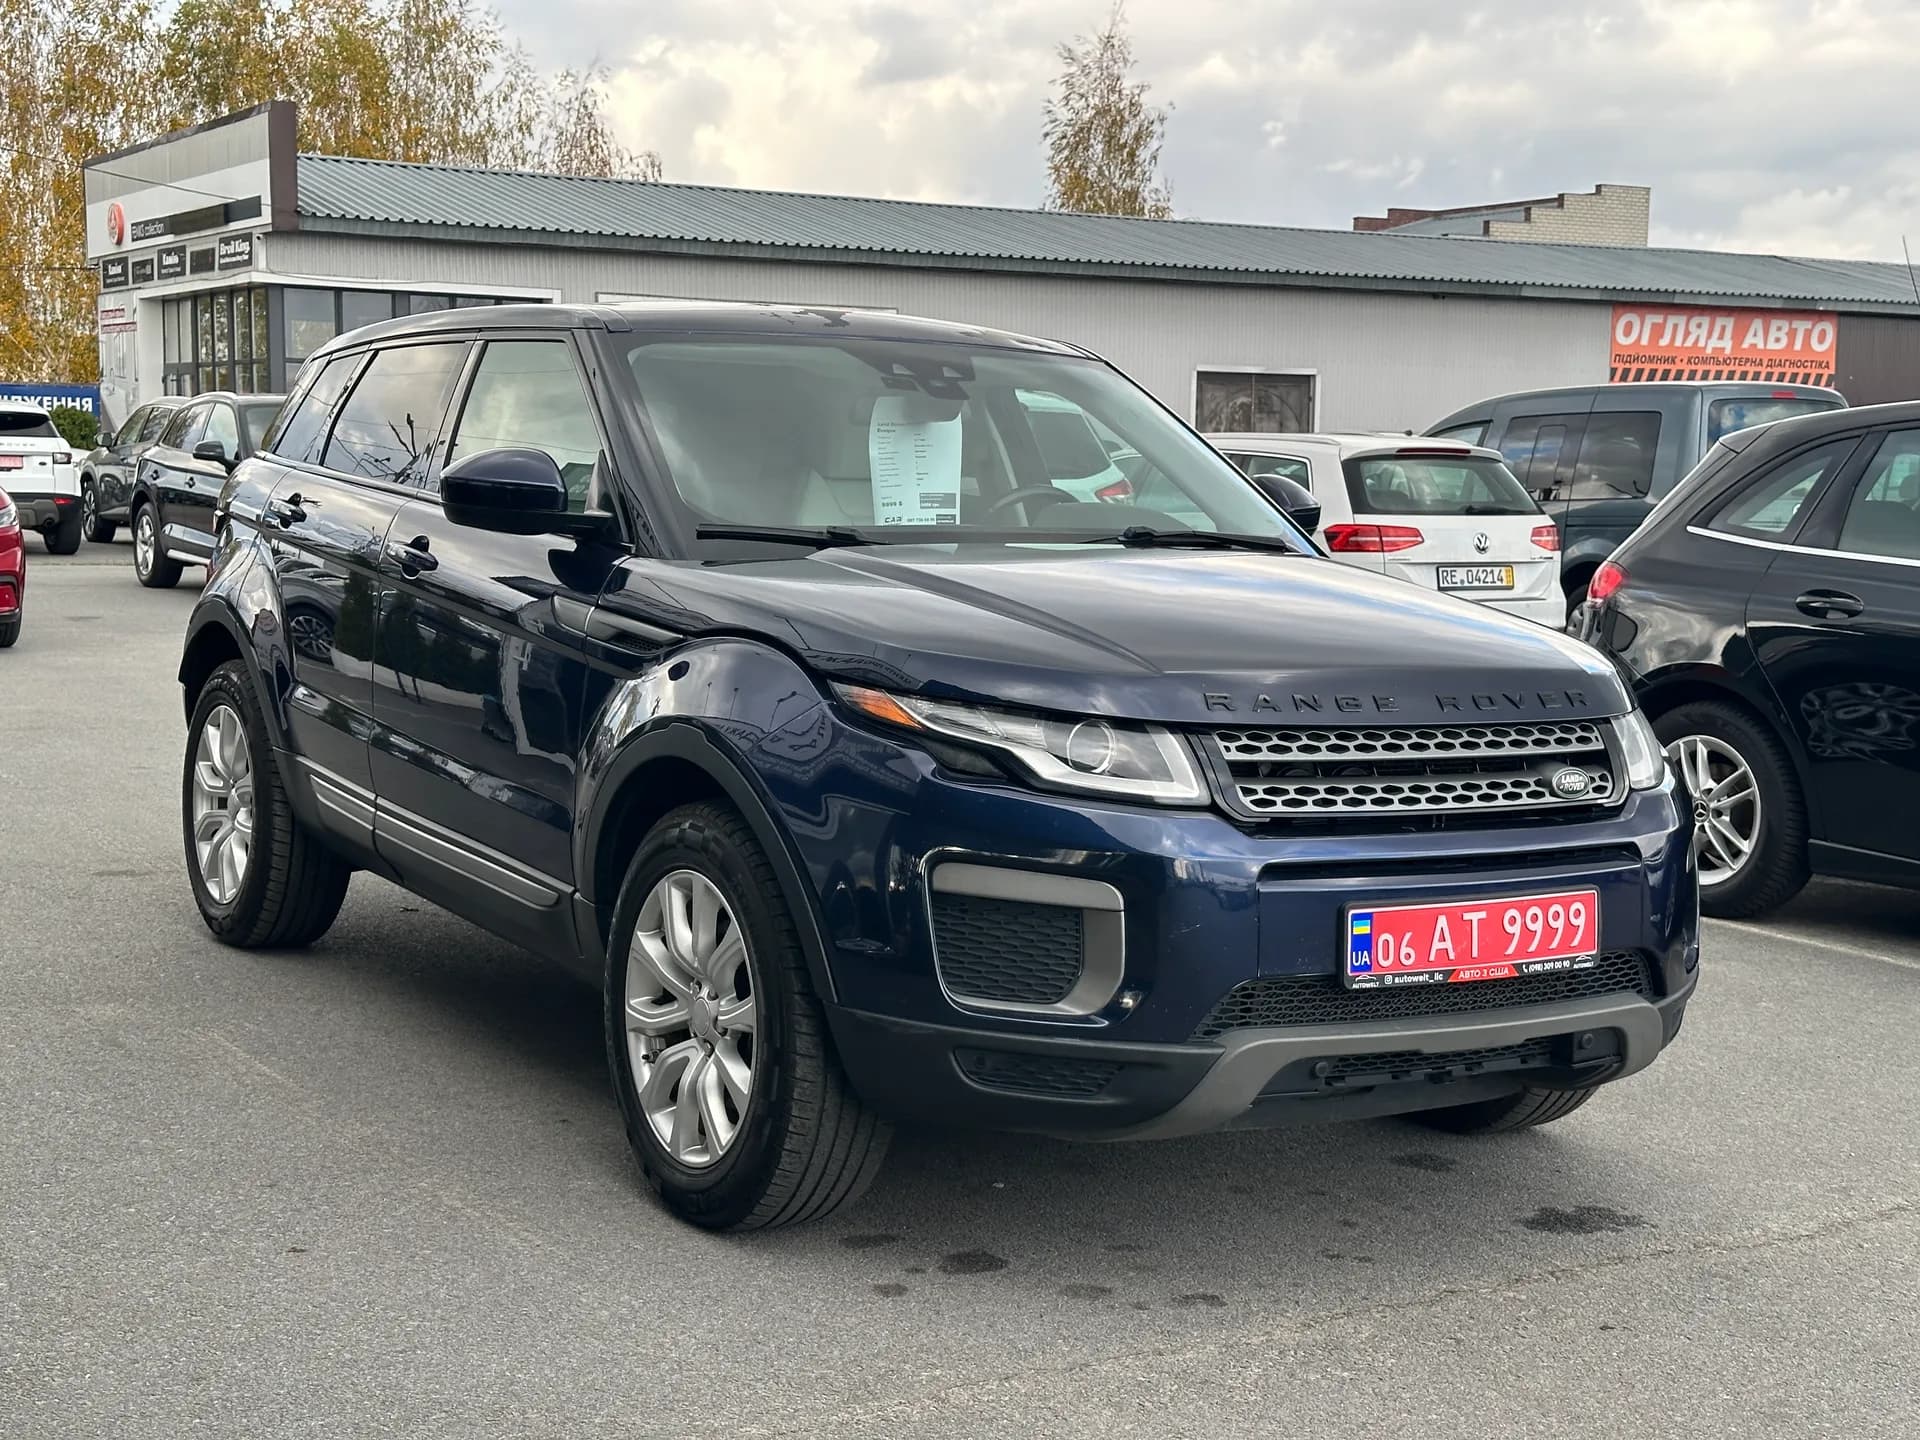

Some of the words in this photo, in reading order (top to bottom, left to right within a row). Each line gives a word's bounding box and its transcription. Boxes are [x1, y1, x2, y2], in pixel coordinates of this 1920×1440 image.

[220, 240, 234, 255] Broil
[1614, 312, 1735, 354] ОГЛЯД
[1741, 317, 1834, 352] АВТО
[1613, 353, 1678, 366] ПІДЙОМНИК
[1765, 358, 1831, 370] ДІАГНОСТІКА
[1203, 692, 1400, 713] RANGE
[1438, 689, 1590, 712] ROVER
[1376, 931, 1416, 968] 06
[1428, 910, 1487, 962] AT
[1502, 901, 1586, 956] 9999
[1352, 950, 1371, 967] UA
[1458, 969, 1481, 979] АВТО
[1489, 967, 1510, 977] США
